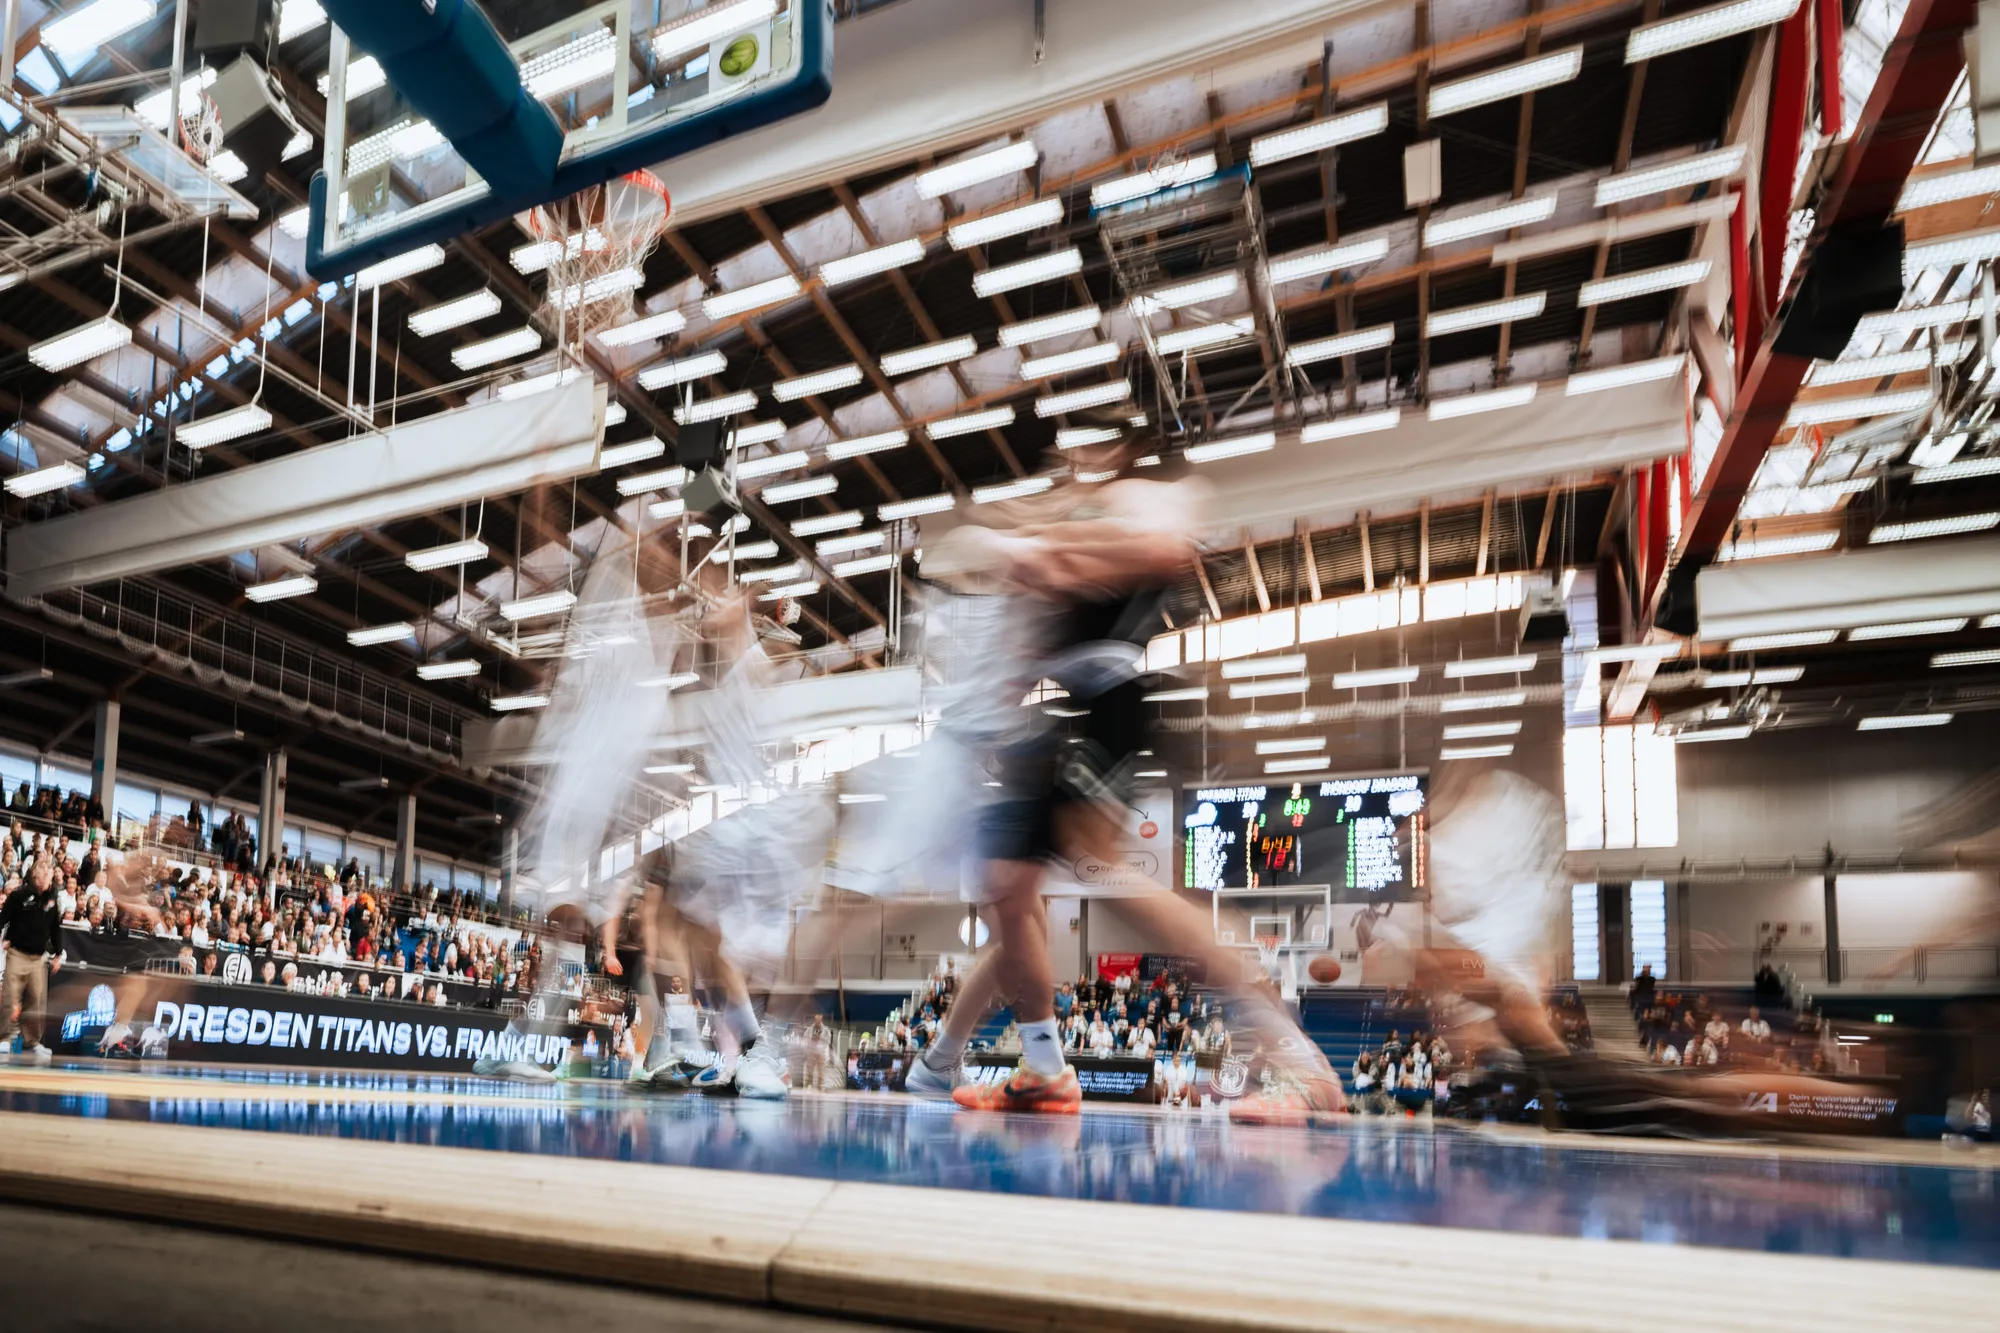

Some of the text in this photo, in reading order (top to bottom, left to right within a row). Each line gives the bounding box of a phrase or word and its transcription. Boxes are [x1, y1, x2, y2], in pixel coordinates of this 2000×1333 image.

[154, 1001, 314, 1048] DRESDEN
[317, 1015, 412, 1056] TITANS
[415, 1023, 451, 1059] VS.
[454, 1027, 571, 1065] FRANKFURT
